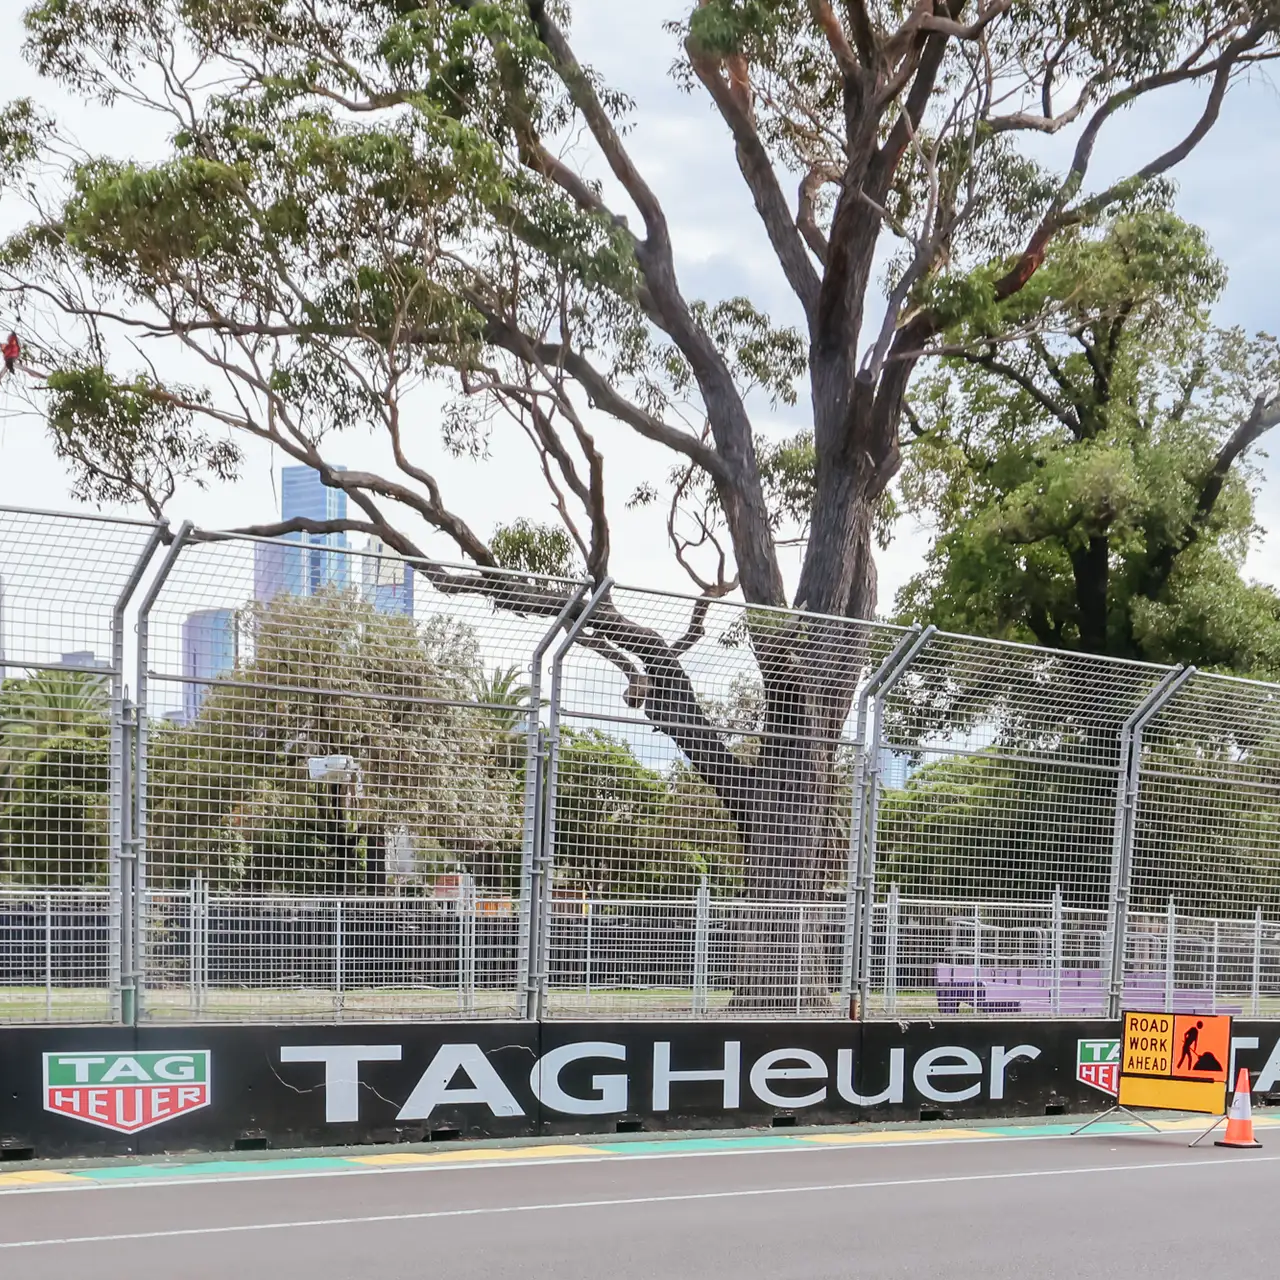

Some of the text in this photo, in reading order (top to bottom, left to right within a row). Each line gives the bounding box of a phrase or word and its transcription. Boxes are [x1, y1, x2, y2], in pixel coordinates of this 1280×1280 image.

[1129, 1017, 1169, 1033] ROAD
[1085, 1042, 1120, 1061] TA
[1129, 1036, 1168, 1052] WORK
[58, 1055, 195, 1083] TAG
[1127, 1056, 1168, 1071] AHEAD
[54, 1087, 201, 1127] HEUER
